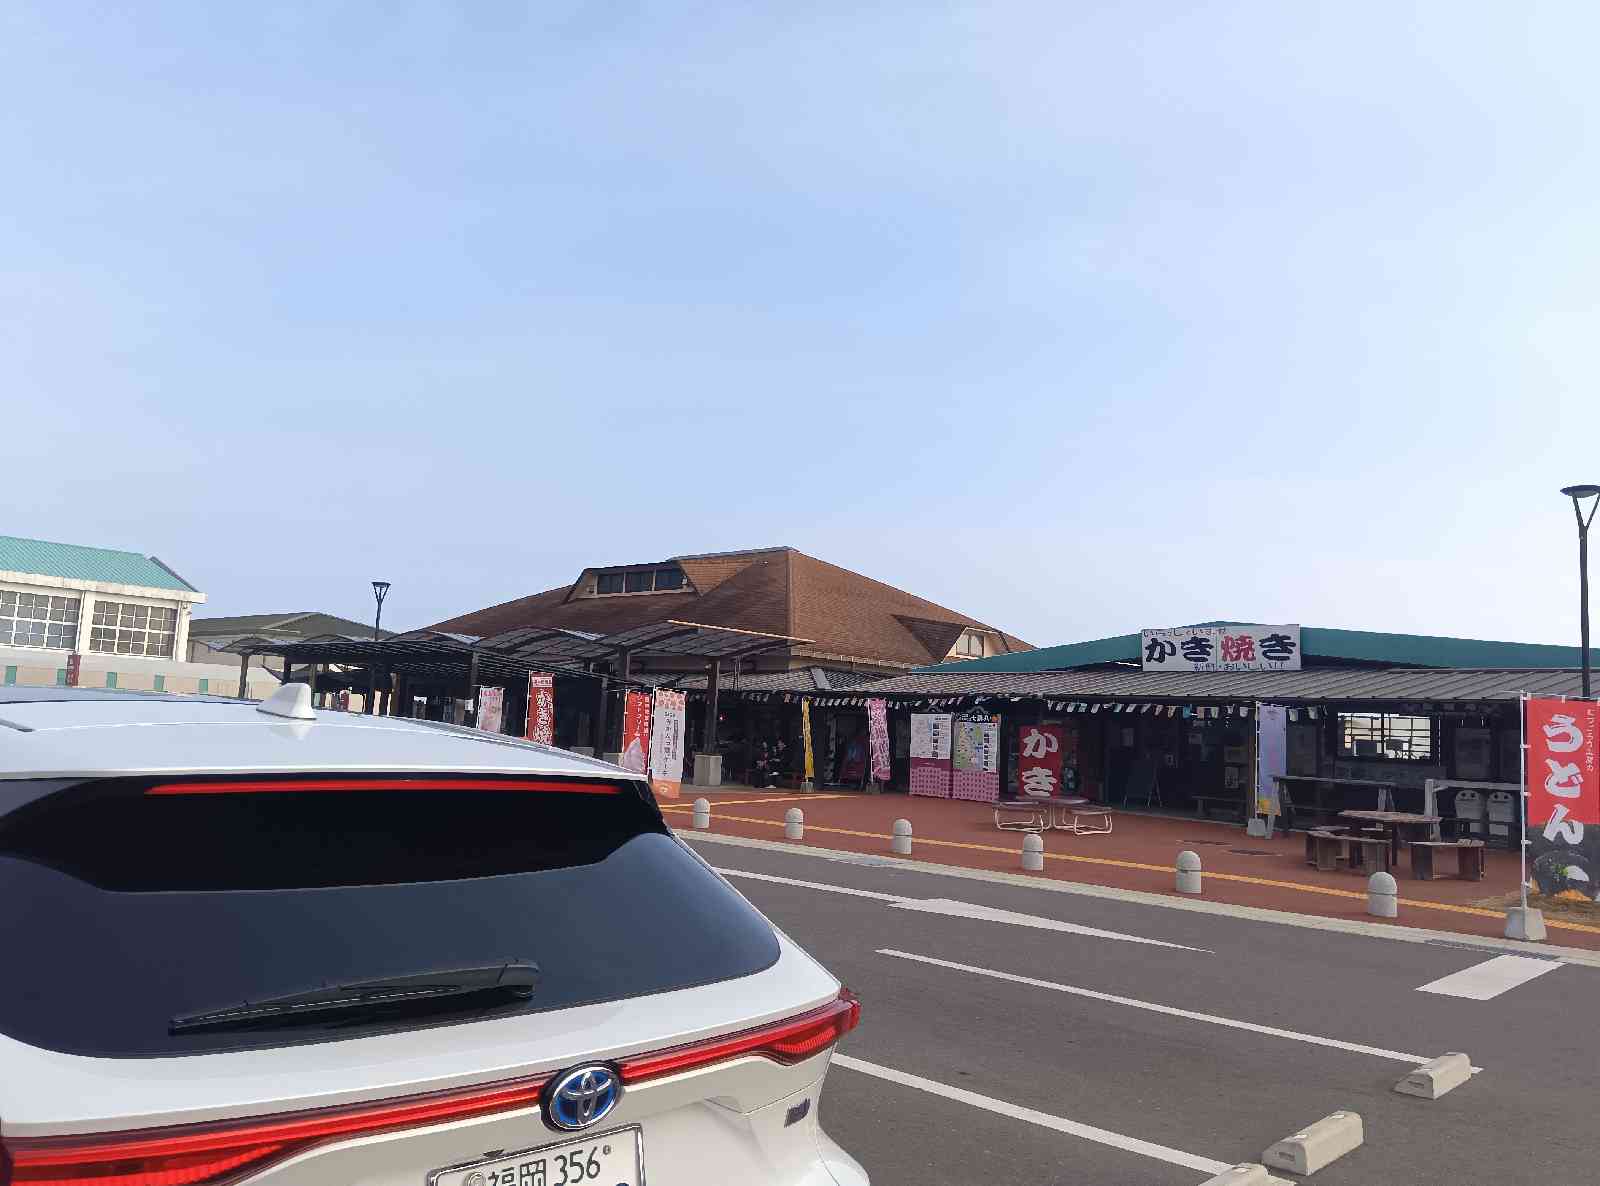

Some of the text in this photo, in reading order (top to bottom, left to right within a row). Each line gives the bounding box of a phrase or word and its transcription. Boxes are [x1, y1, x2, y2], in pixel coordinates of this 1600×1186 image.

[1144, 633, 1297, 663] かき焼き
[1022, 728, 1059, 797] かき
[1542, 713, 1584, 845] うどん
[554, 1146, 601, 1186] 356
